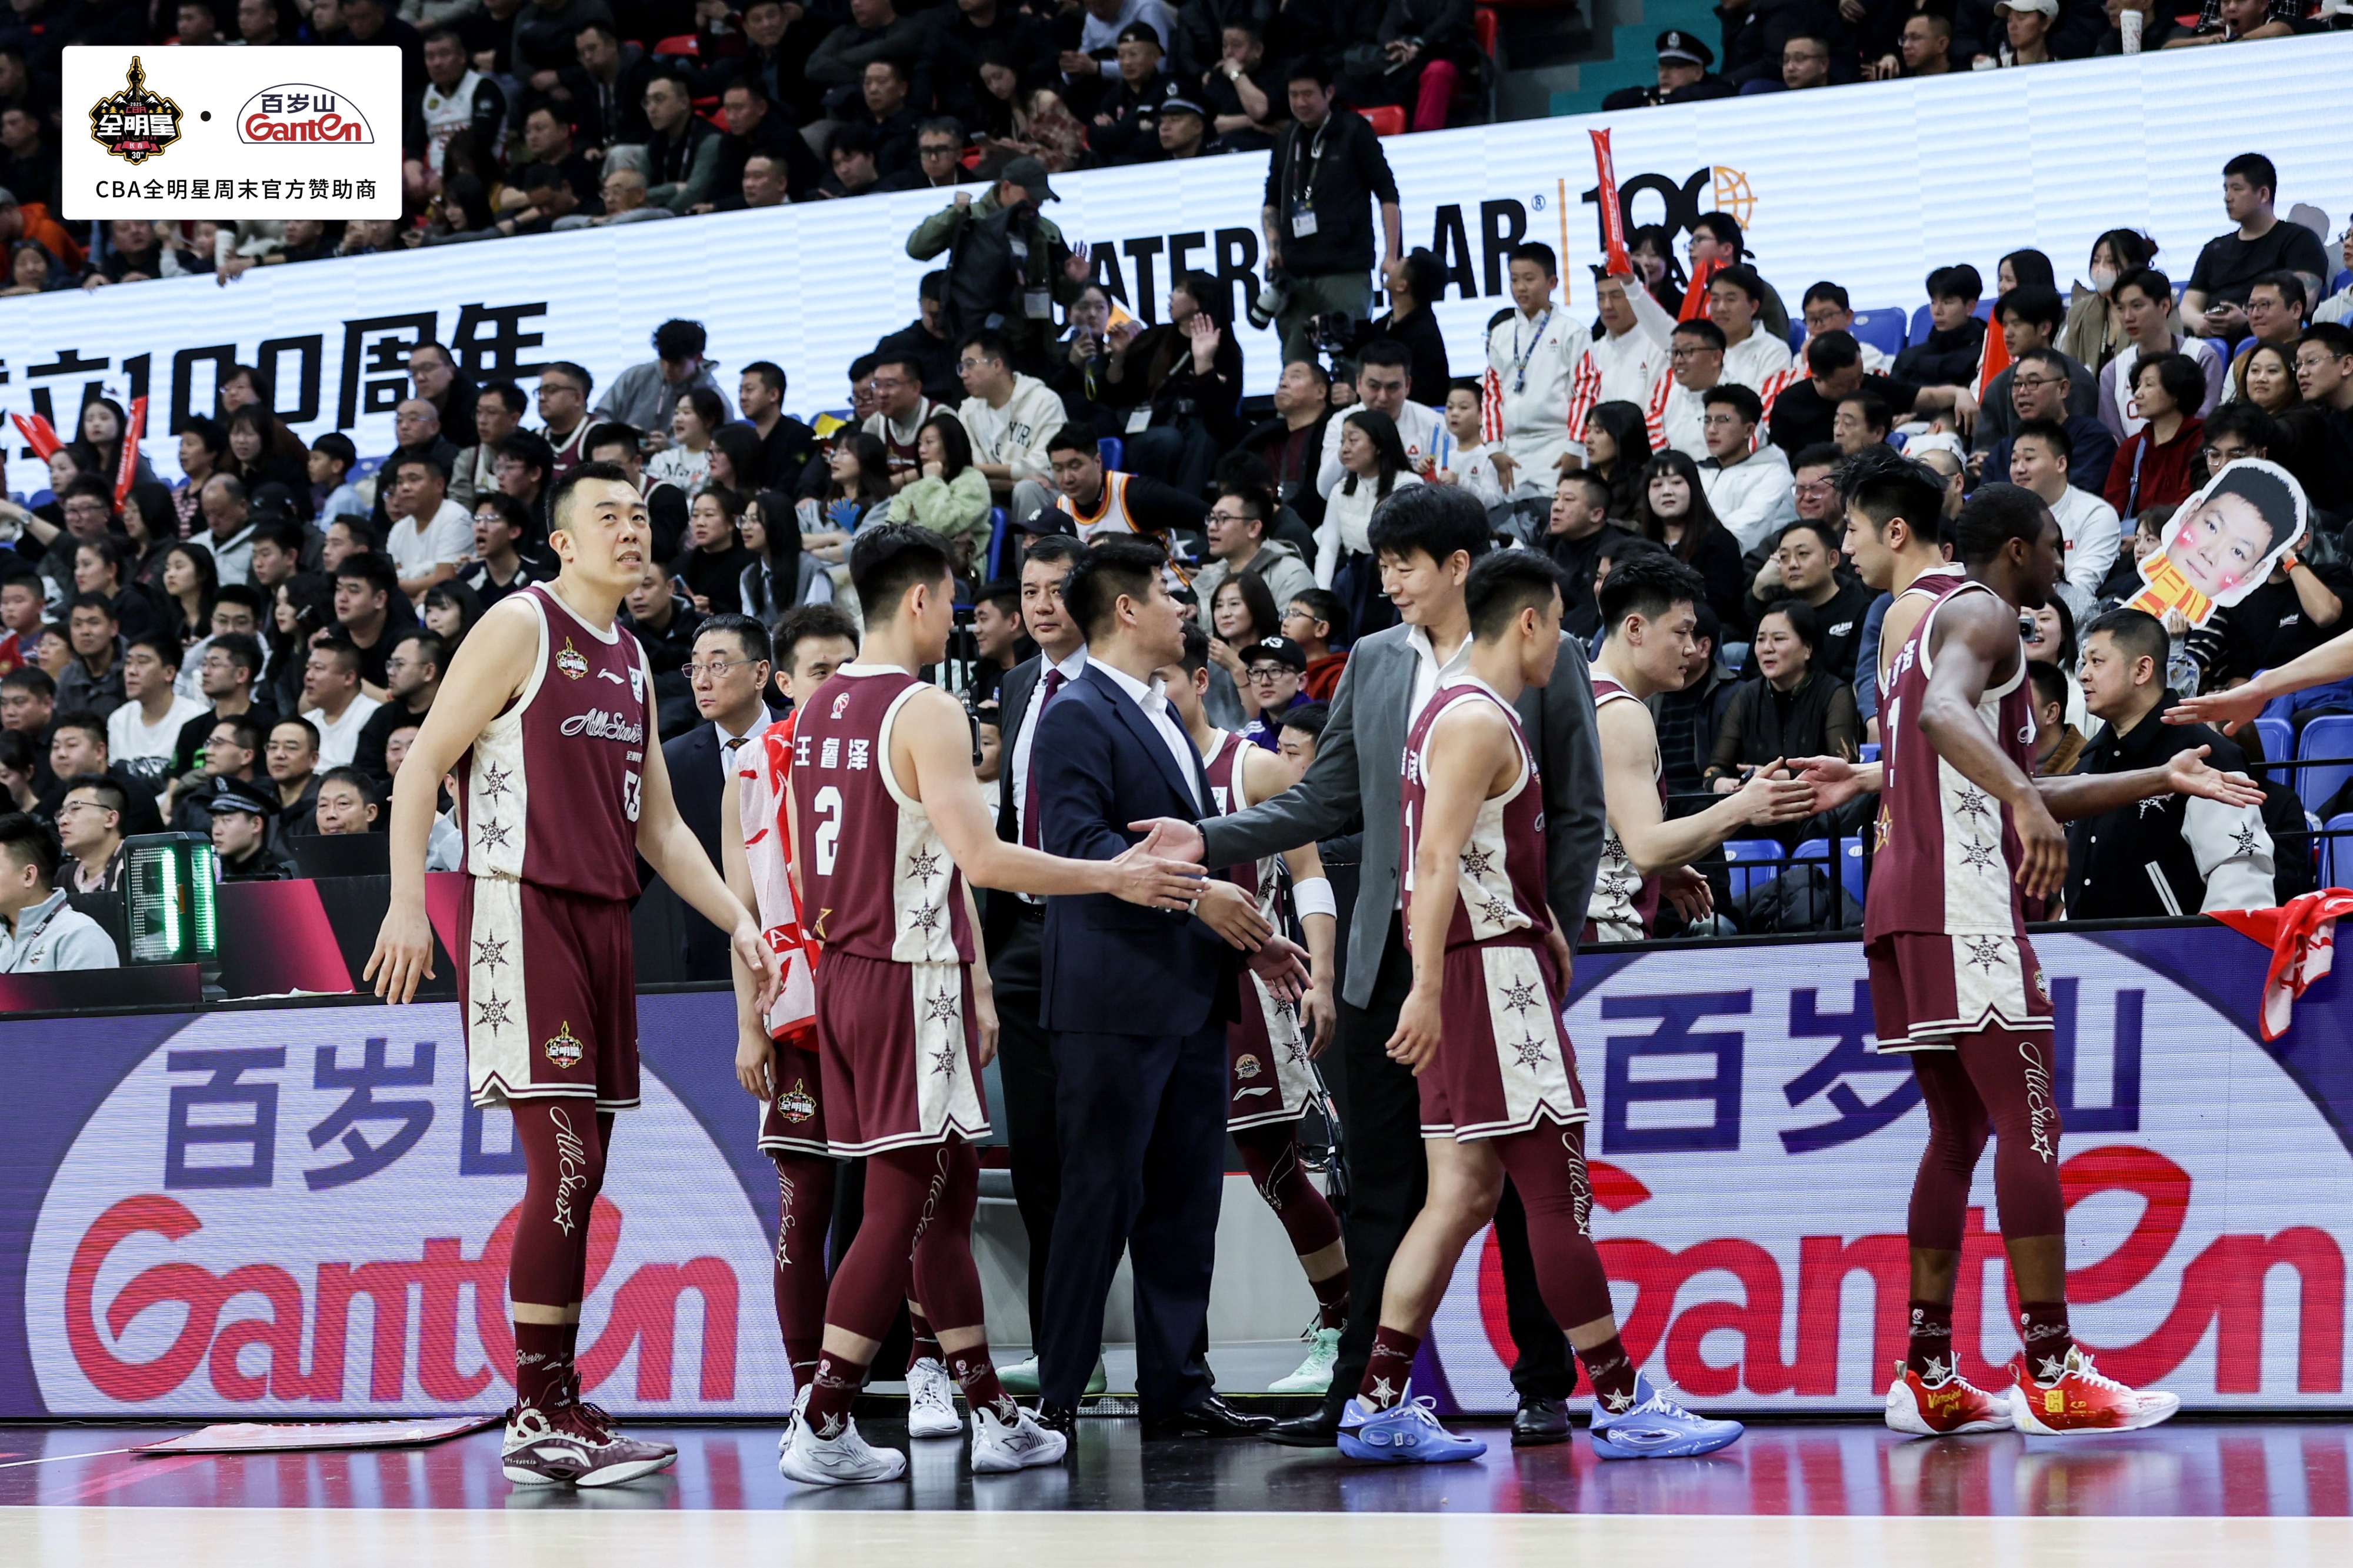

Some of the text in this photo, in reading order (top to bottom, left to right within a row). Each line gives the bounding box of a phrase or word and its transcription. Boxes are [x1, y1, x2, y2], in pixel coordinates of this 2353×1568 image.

[0, 302, 548, 460] 立100周年
[795, 736, 869, 770] 王睿泽
[814, 785, 843, 876] 2
